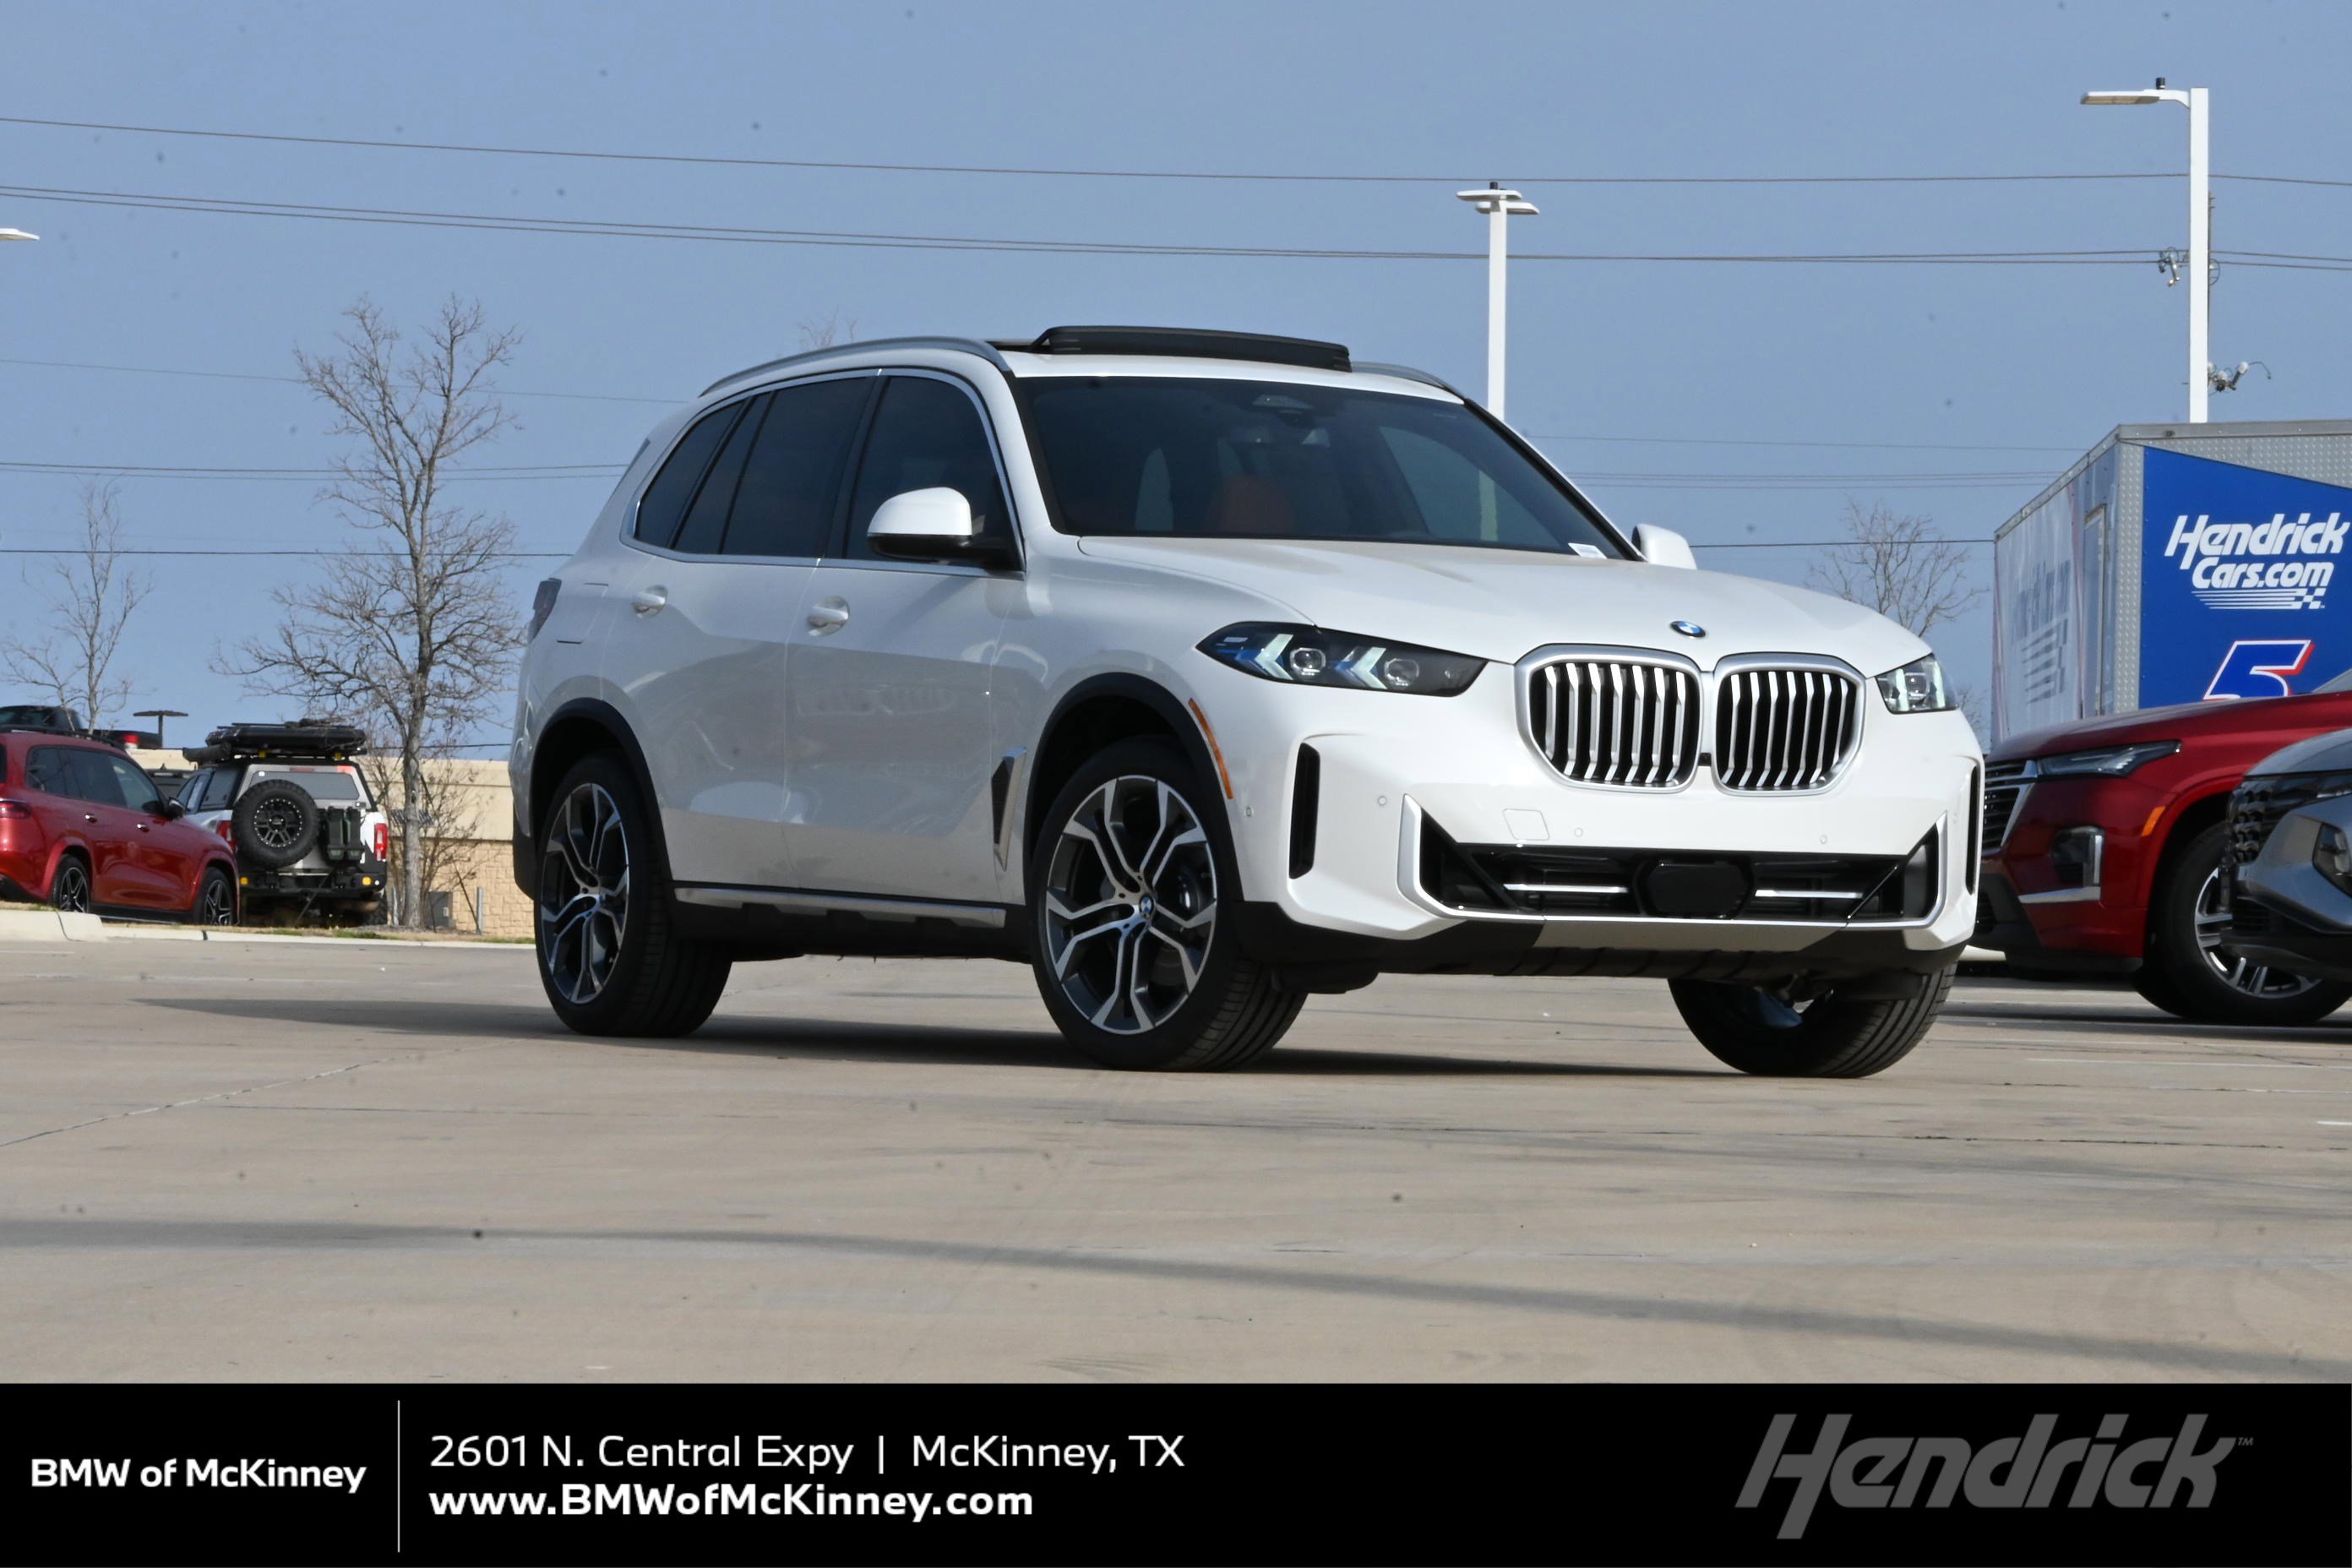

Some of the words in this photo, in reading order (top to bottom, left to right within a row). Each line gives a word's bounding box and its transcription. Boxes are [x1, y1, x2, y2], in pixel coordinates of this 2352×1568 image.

[2164, 513, 2350, 570] Hendrick
[2191, 557, 2334, 589] Cars.com
[2202, 639, 2315, 700] 5
